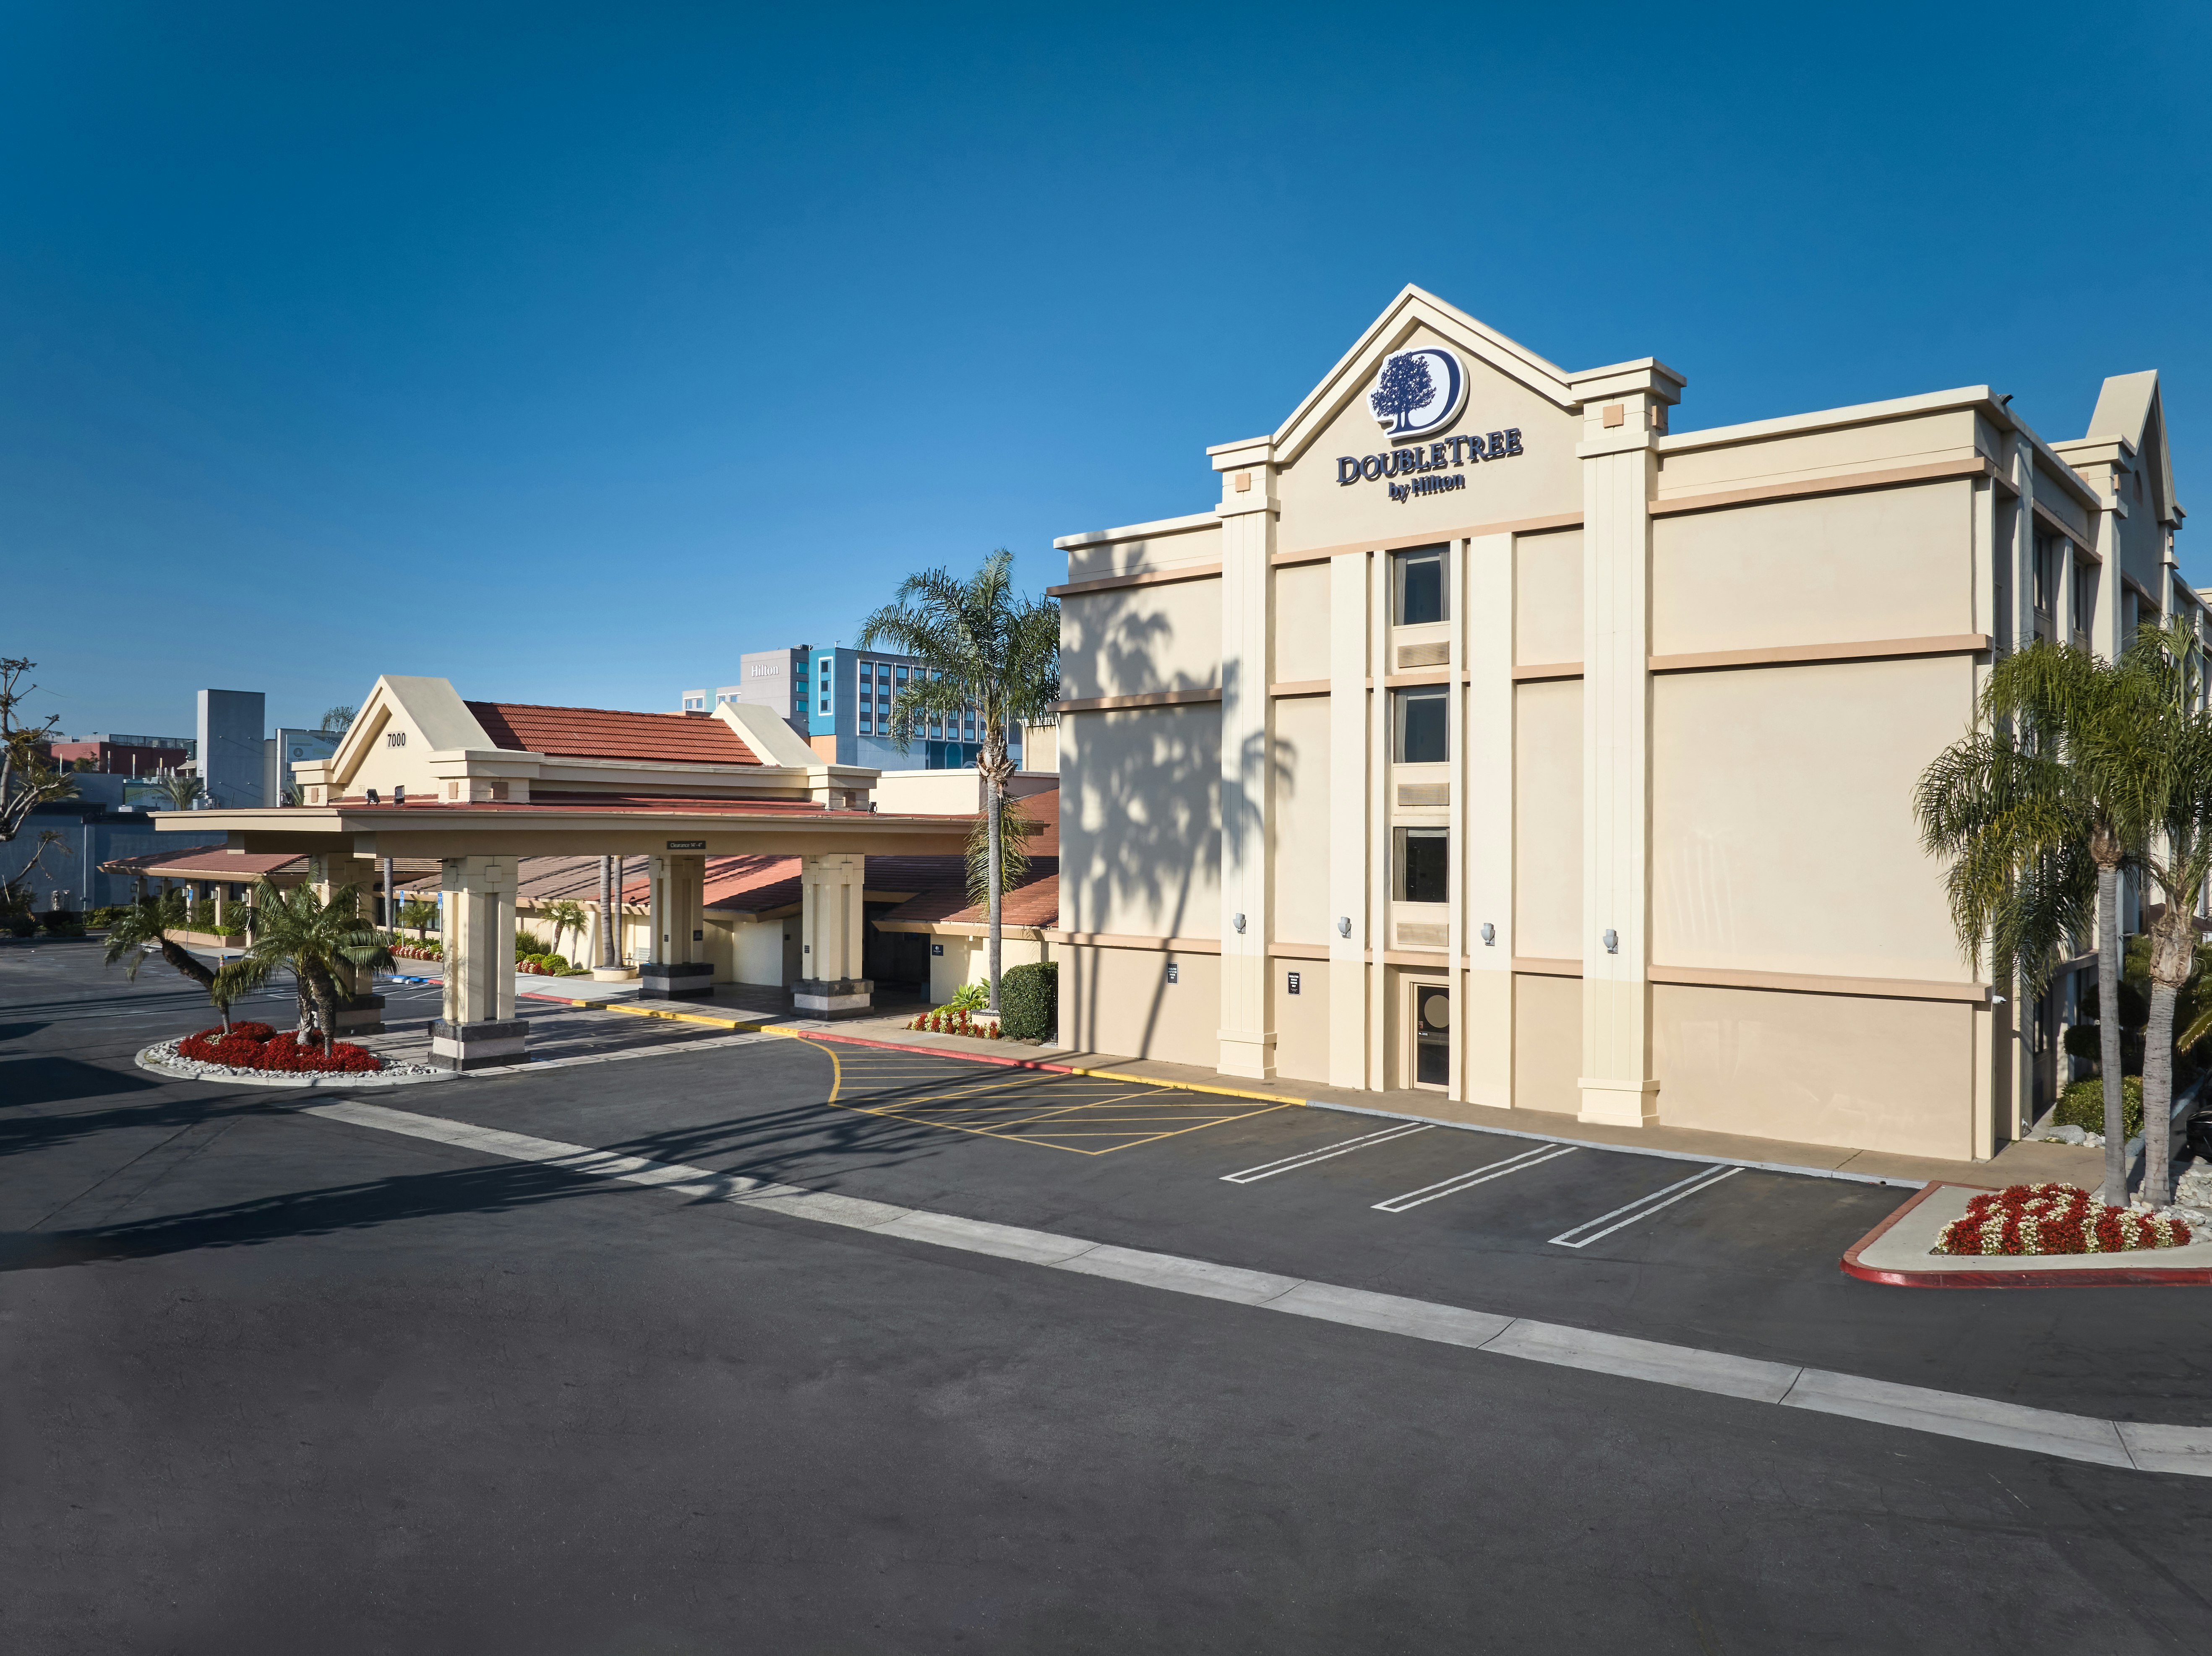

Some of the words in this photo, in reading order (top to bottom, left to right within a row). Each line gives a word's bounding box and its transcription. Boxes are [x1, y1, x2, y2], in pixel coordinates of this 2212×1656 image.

[1336, 428, 1522, 483] DOUBLETREE
[1388, 482, 1411, 501] by
[1411, 474, 1464, 494] Hilton
[751, 664, 779, 677] Hilton
[388, 732, 405, 747] 7000
